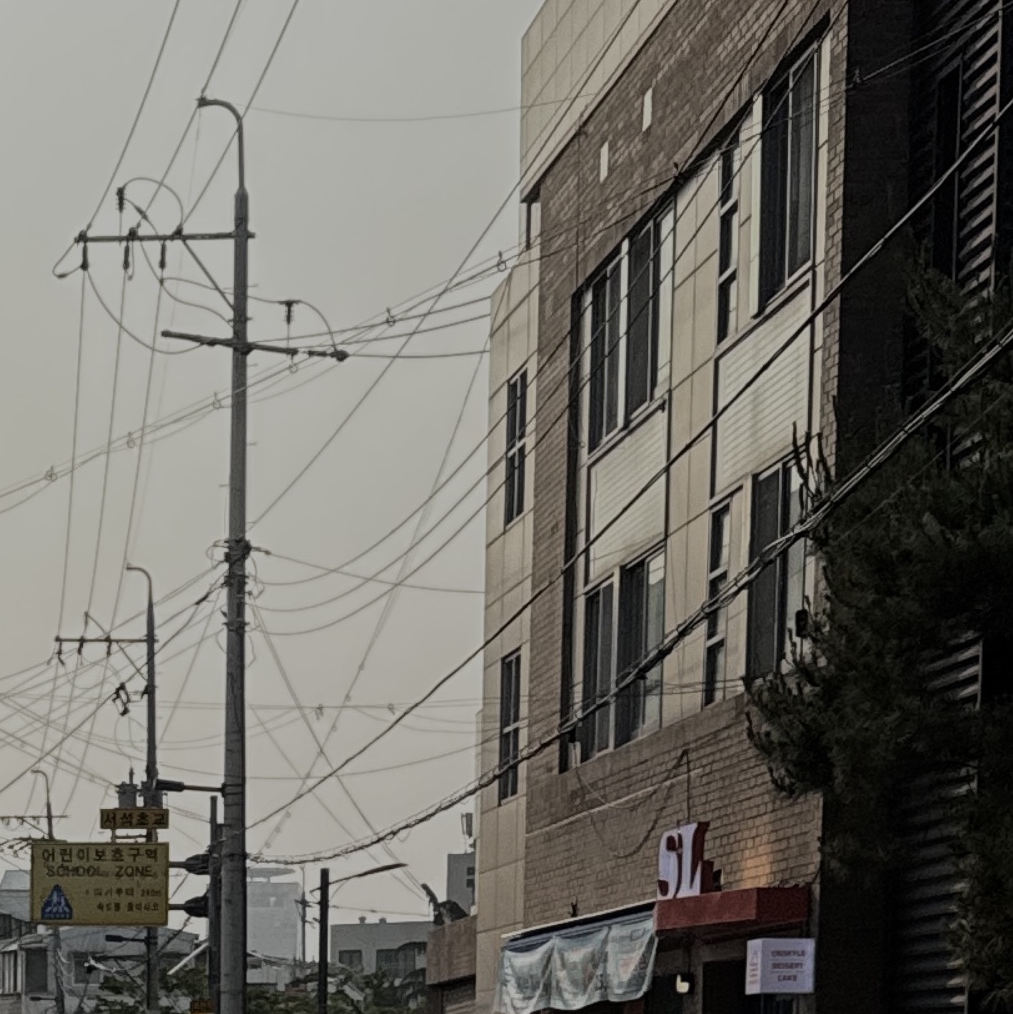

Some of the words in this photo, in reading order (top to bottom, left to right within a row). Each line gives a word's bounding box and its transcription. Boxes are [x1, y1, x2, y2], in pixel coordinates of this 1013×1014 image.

[42, 847, 157, 862] 어린이보호구역
[47, 865, 105, 877] SCHOOL
[115, 865, 154, 878] ZONE
